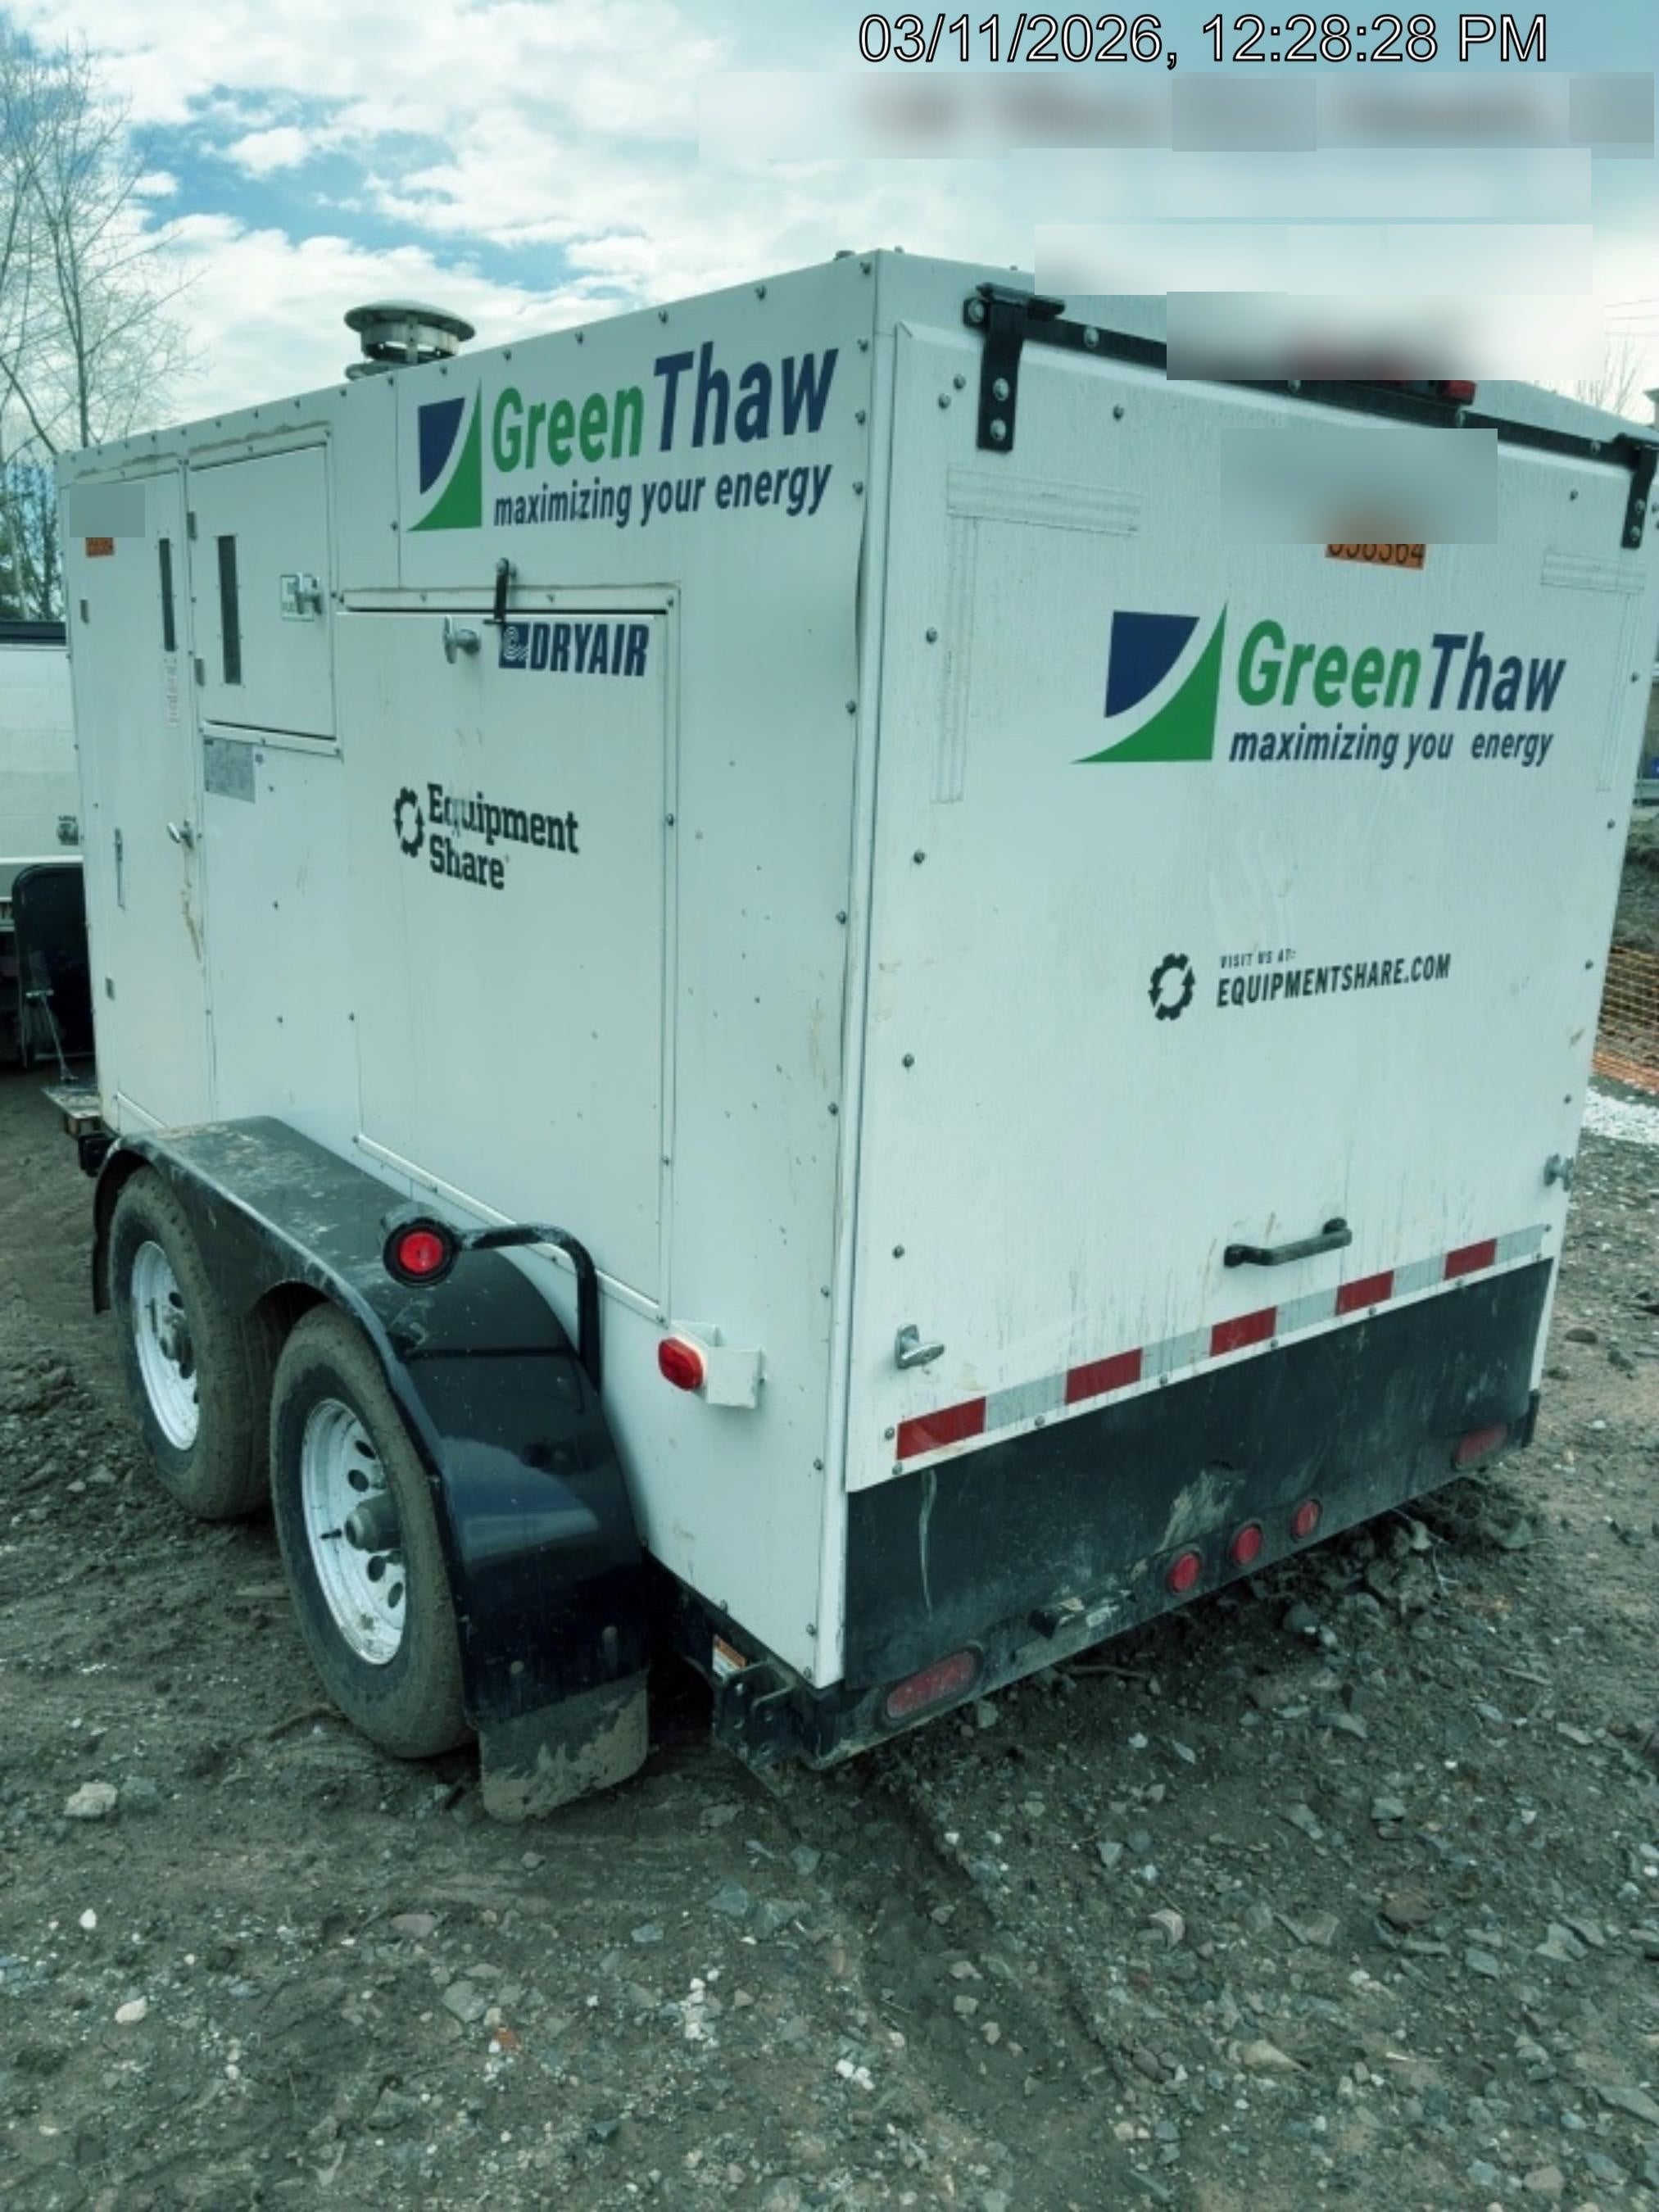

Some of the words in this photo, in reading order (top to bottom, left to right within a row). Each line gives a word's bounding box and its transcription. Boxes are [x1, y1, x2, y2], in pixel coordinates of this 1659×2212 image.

[493, 475, 632, 529] maximizing
[640, 470, 706, 526] your
[714, 463, 833, 517] energy
[530, 622, 650, 677] DRYAIR
[1228, 721, 1398, 770] maximizing
[1403, 729, 1454, 769] you
[1471, 732, 1554, 768] energy
[427, 782, 580, 854] Equipment
[1217, 953, 1452, 1008] EQUIPMENTSHARE.COM
[1220, 952, 1253, 969] VISIT
[1258, 950, 1272, 965] US
